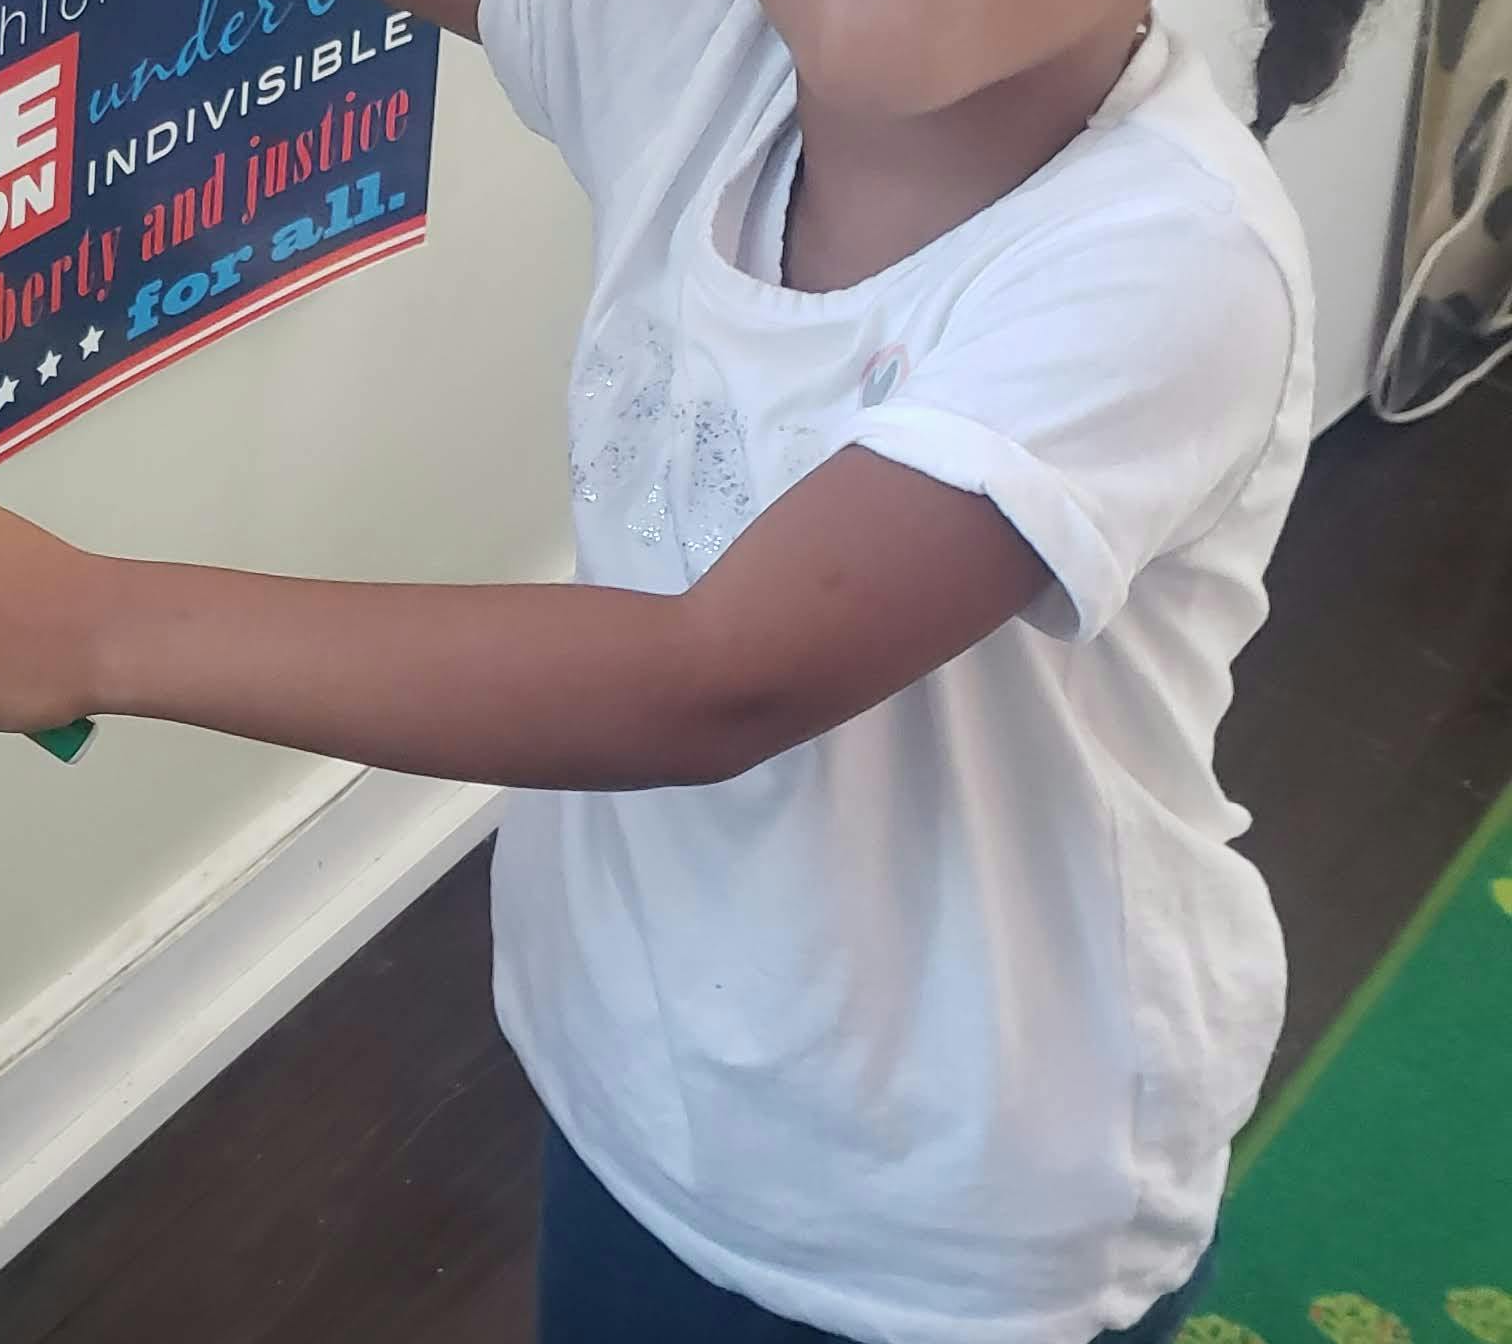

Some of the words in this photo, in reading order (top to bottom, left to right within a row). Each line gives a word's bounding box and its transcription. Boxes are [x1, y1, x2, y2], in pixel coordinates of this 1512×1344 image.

[88, 10, 414, 196] INDIVISIBLE
[142, 153, 226, 262] and
[242, 88, 409, 224] justice
[126, 245, 253, 341] for
[270, 171, 406, 262] all.
